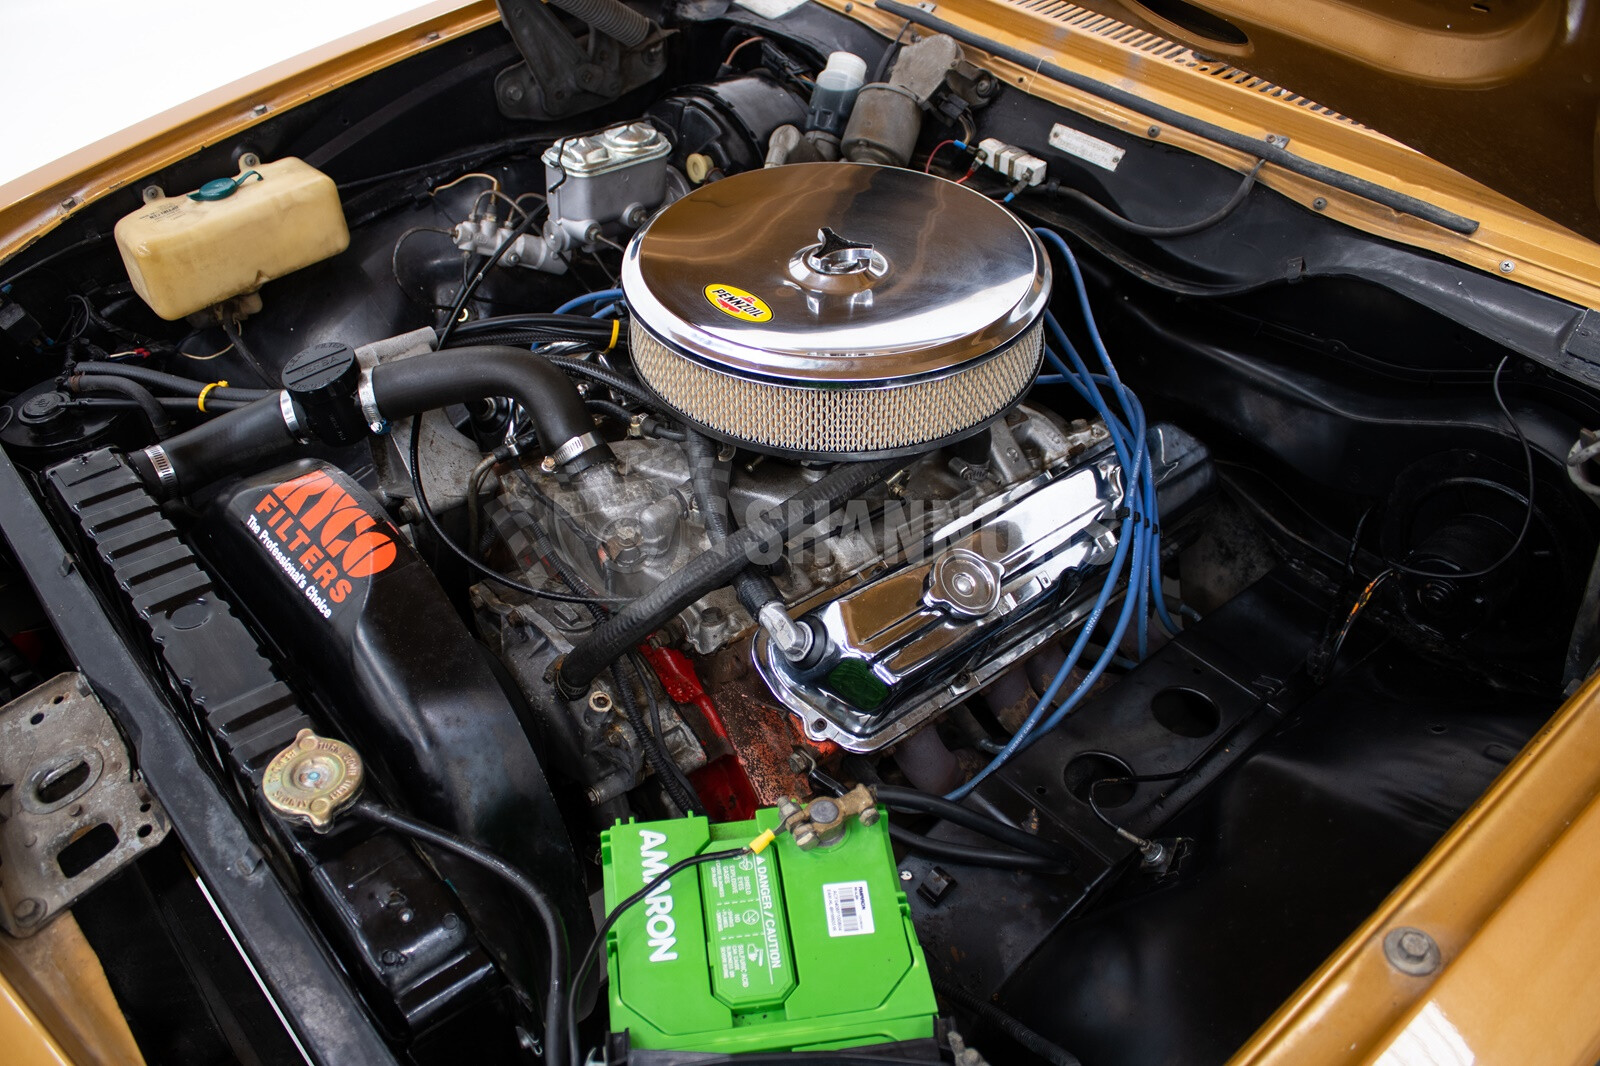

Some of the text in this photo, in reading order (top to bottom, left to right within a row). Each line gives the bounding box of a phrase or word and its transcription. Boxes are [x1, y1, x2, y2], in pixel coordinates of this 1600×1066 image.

[712, 288, 764, 316] PENNZOIL
[246, 514, 332, 619] The Professional's Choice
[255, 494, 352, 603] FILTERS
[272, 470, 397, 578] RYCO
[639, 830, 678, 962] AMARON
[758, 867, 772, 909] DANGER
[766, 920, 781, 968] CAUTION
